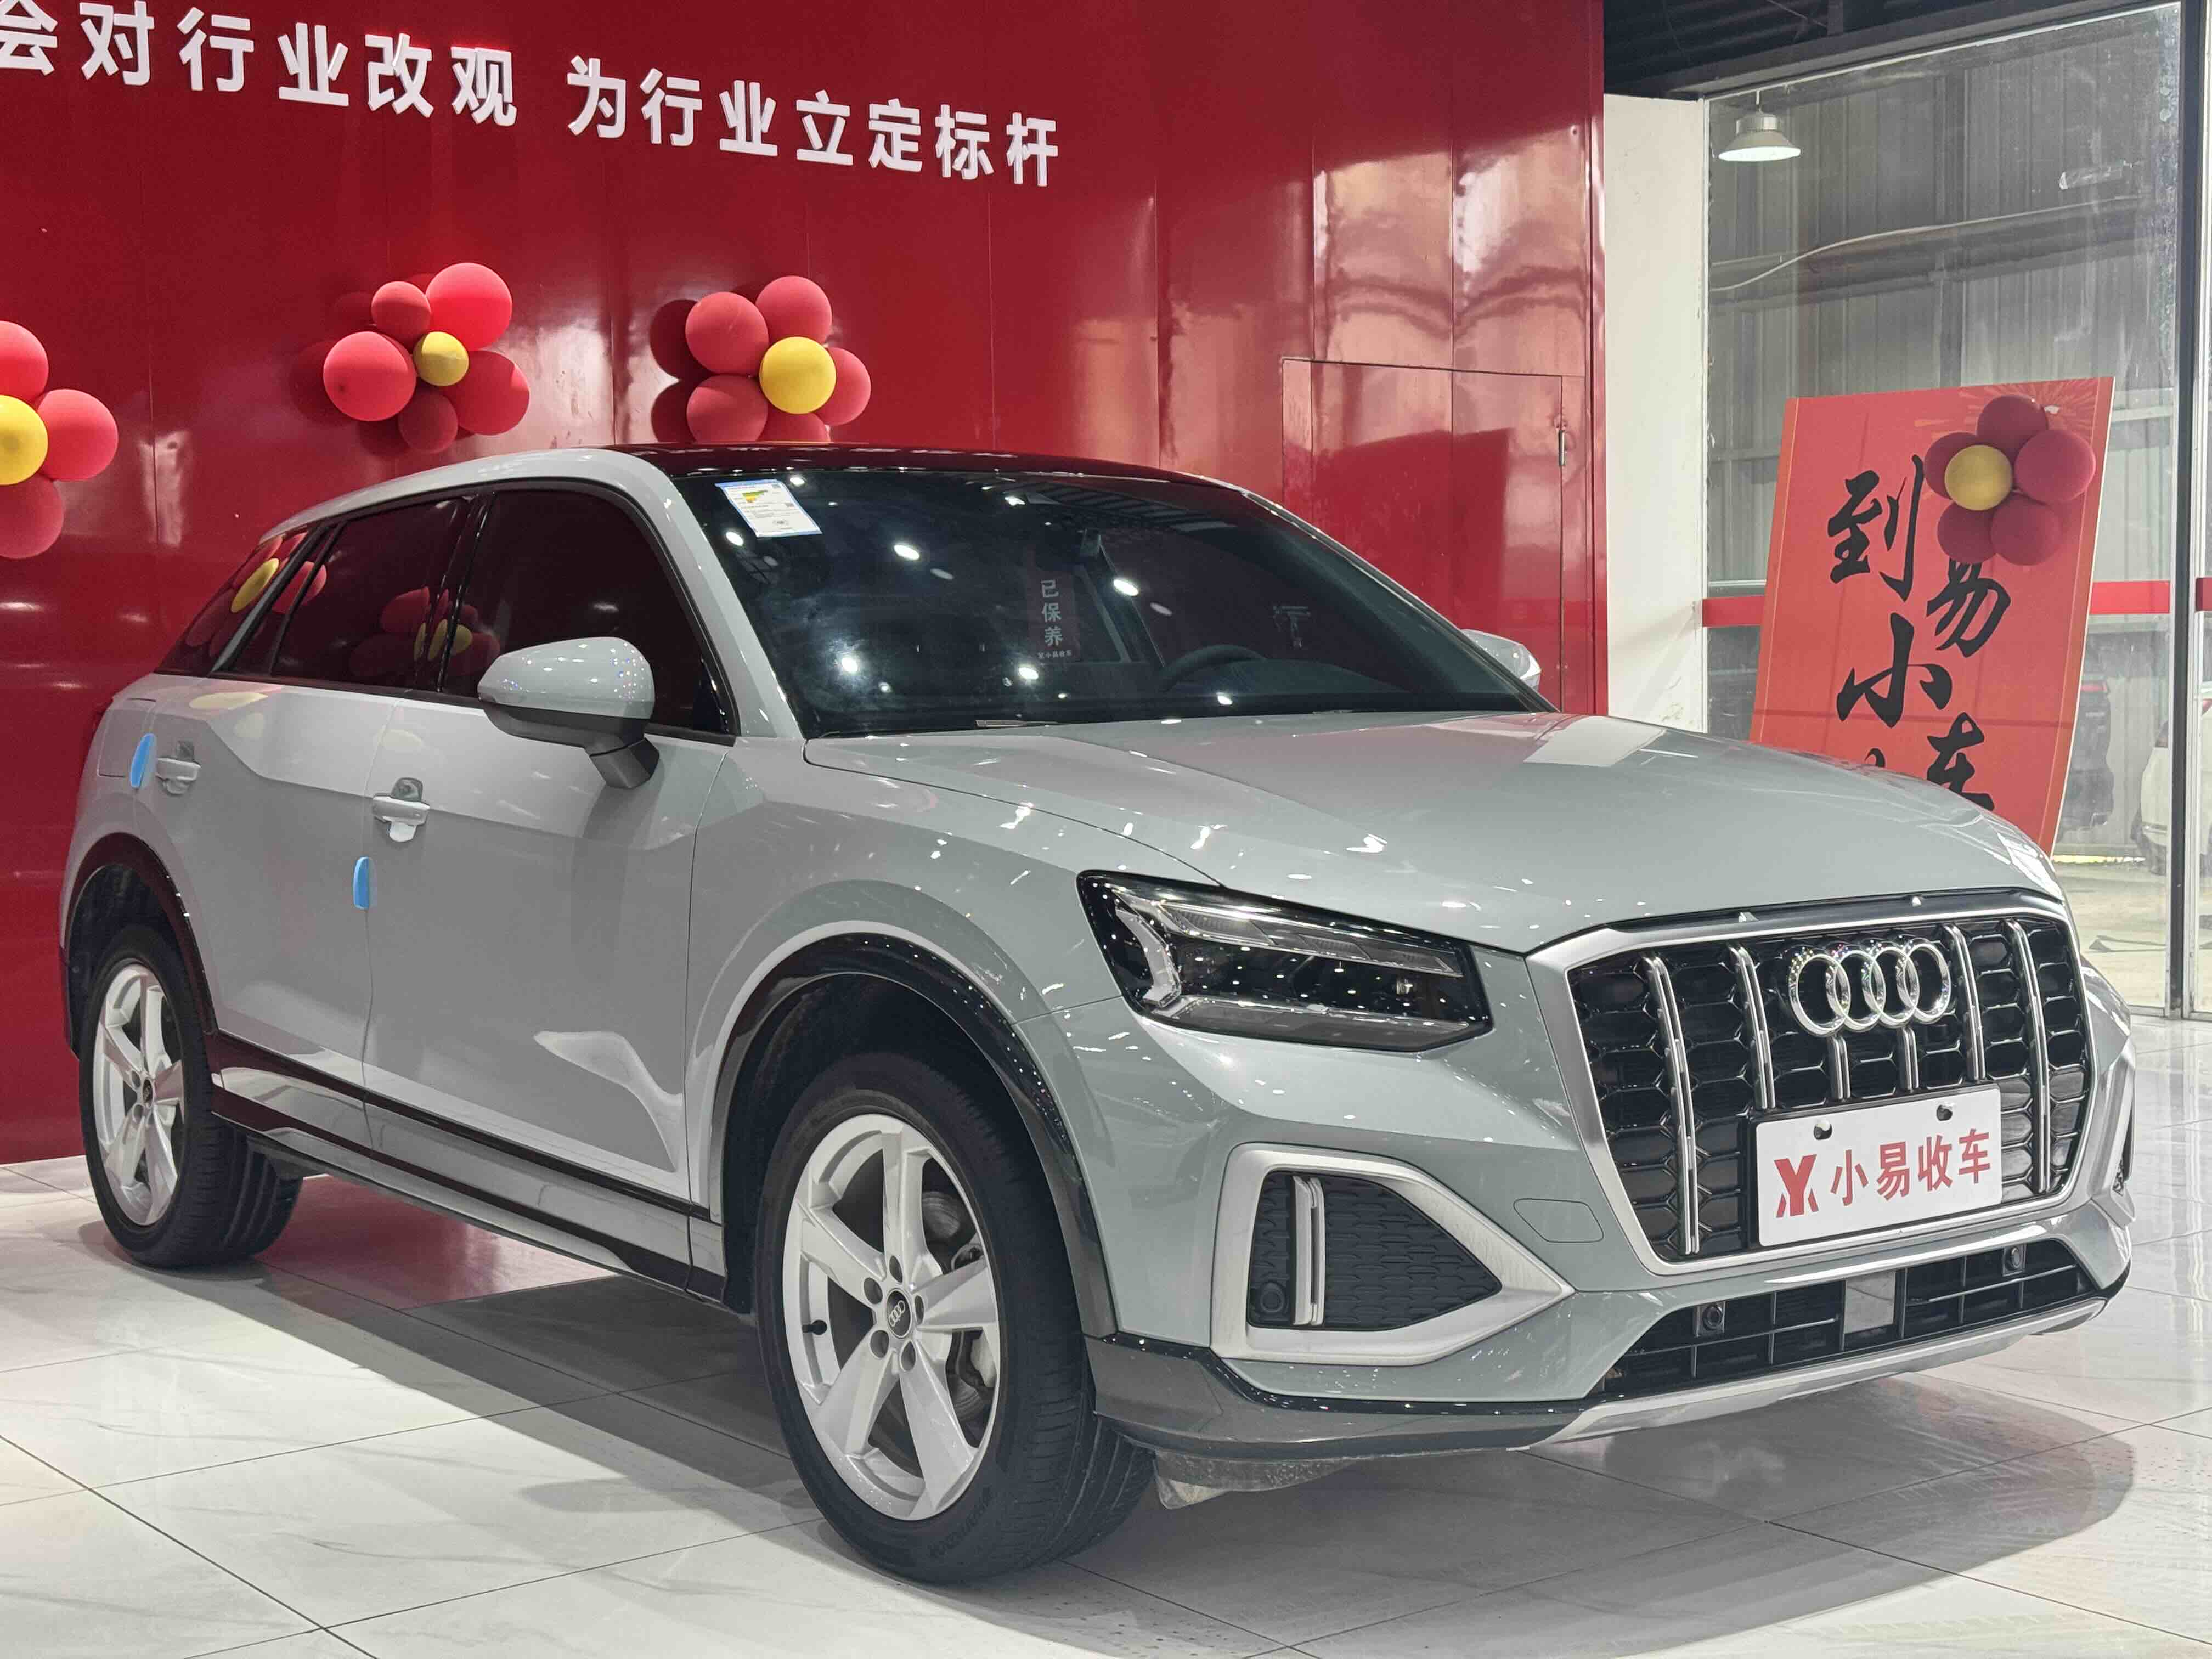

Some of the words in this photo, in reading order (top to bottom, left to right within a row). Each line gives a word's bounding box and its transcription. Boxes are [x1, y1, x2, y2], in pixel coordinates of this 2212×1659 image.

[0, 0, 517, 127] 会对行业改观
[567, 55, 1058, 187] 为行业立定标杆
[1041, 579, 1064, 647] 已保养
[1831, 1129, 1991, 1206] 小易收车
